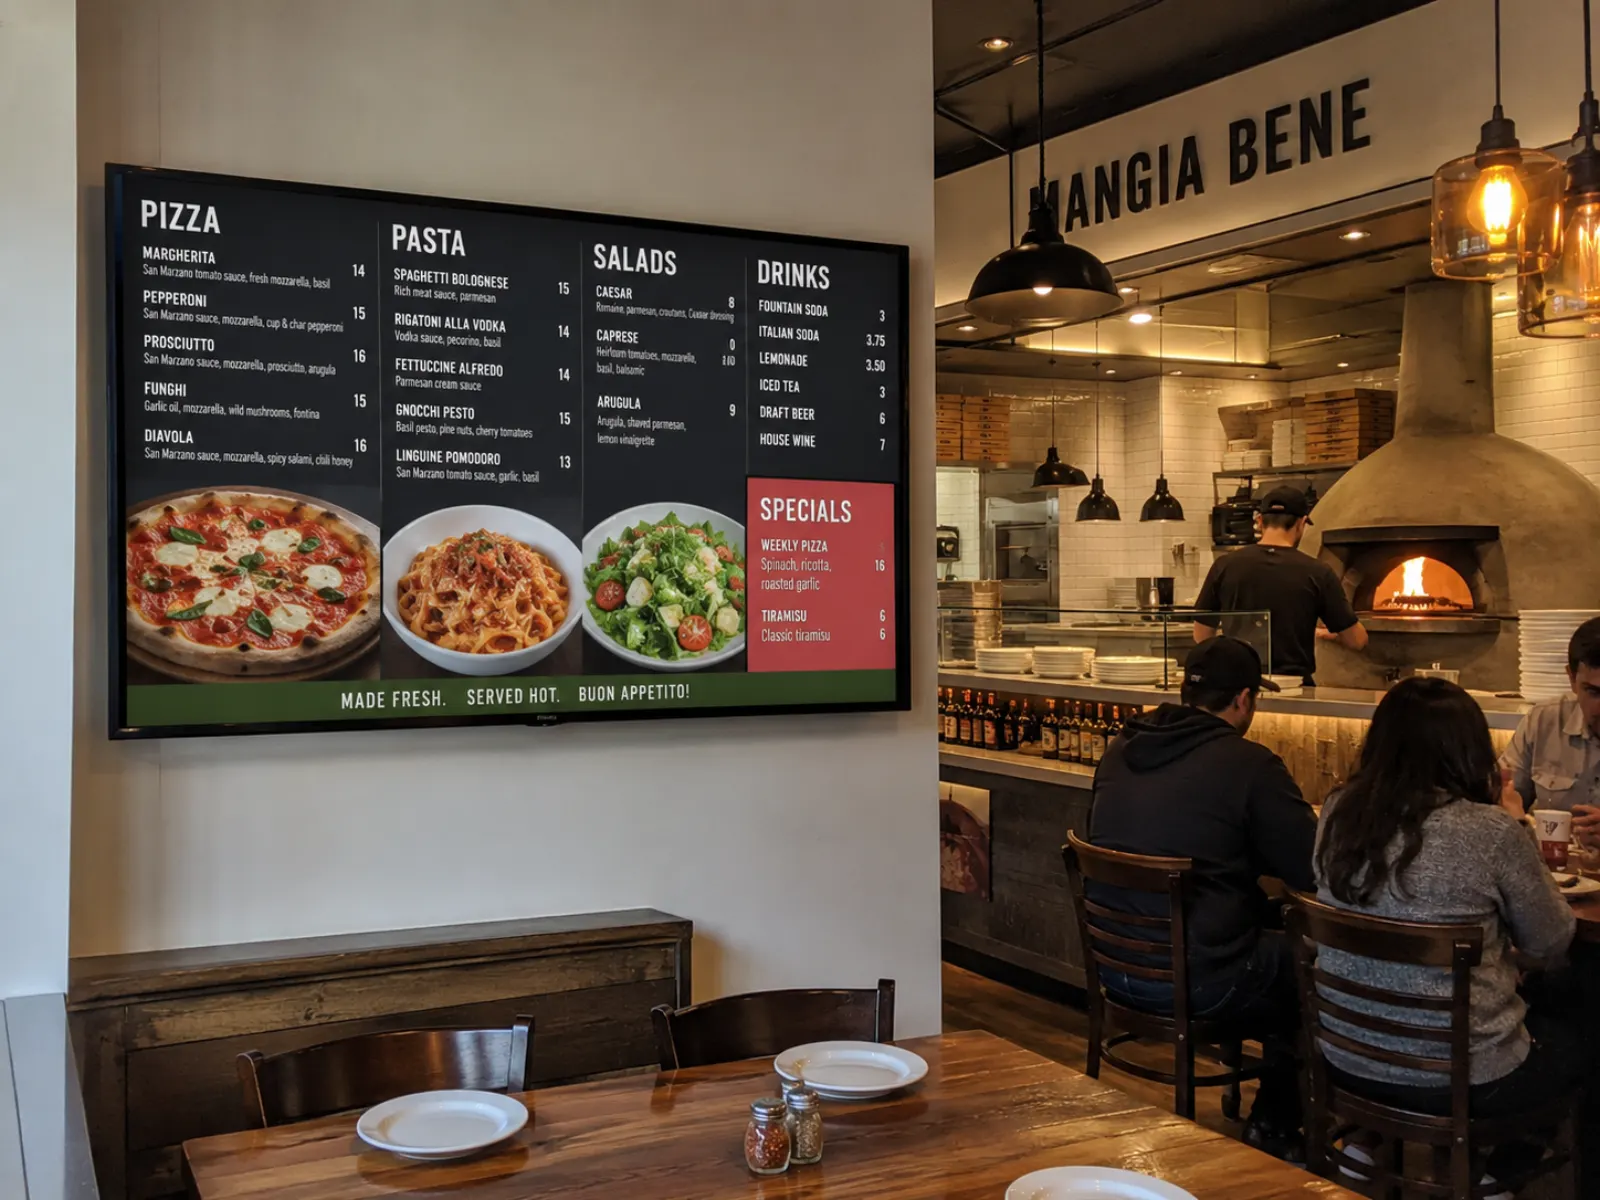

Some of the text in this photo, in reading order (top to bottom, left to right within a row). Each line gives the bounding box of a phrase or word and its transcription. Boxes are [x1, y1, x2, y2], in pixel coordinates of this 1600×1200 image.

[1229, 78, 1371, 185] BENE
[142, 200, 220, 233] PIZZA
[393, 224, 465, 256] PASTA
[143, 246, 215, 264] MARGHERITA
[594, 244, 676, 275] SALADS
[143, 264, 330, 288] San Marzano tomato sauce, fresh mozzarella, basil
[353, 264, 365, 277] 14
[758, 260, 829, 289] DRINKS
[394, 268, 508, 289] SPAGHETTI BOLOGNESE
[394, 285, 411, 296] Rich
[413, 289, 432, 298] meat
[434, 290, 458, 301] sauce,
[559, 282, 569, 295] 15
[596, 285, 632, 299] CAESAR
[144, 290, 206, 307] PEPPERONI
[729, 297, 734, 308] 8
[353, 306, 365, 320] 15
[759, 300, 828, 316] FOUNTAIN SODA
[143, 307, 343, 333] San Marzano sauce, mozzarella, cup & char pepperoni
[395, 313, 506, 332] RIGATONI ALLA VODKA
[880, 310, 885, 322] 3
[395, 330, 418, 342] Vodka
[421, 334, 445, 345] sauce,
[559, 325, 569, 338] 14
[597, 329, 638, 343] CAPRESE
[759, 326, 819, 341] ITALIAN SODA
[144, 335, 214, 351] PROSCIUTTO
[867, 334, 885, 347] 3.75
[354, 349, 366, 363] 16
[760, 352, 807, 367] LEMONADE
[144, 352, 159, 364] San
[161, 354, 194, 366] Marzano
[196, 359, 221, 369] sauce,
[223, 359, 266, 371] mozzarella,
[308, 364, 336, 377] arugula
[396, 358, 503, 377] FETTUCCINE ALFREDO
[866, 359, 885, 372] 3.50
[559, 368, 570, 381] 14
[145, 382, 186, 397] FUNGHI
[395, 375, 481, 391] Parmesan cream sauce
[760, 379, 800, 392] ICED TEA
[880, 386, 885, 398] 3
[354, 394, 366, 407] 15
[598, 396, 641, 409] ARUGULA
[144, 400, 320, 419] Garlic oil, mozzarella, wild mushrooms, fontina
[396, 403, 474, 419] GNOCCHI PESTO
[730, 404, 735, 416] 9
[760, 406, 814, 420] DRAFT BEER
[560, 412, 570, 425] 15
[880, 412, 885, 424] 6
[145, 429, 193, 443] DIAVOLA
[396, 421, 414, 432] Basil
[416, 424, 438, 435] pesto,
[440, 423, 455, 436] pine
[456, 426, 474, 436] nuts,
[476, 425, 499, 439] cherry
[355, 439, 367, 452] 16
[760, 433, 815, 447] HOUSE WINE
[880, 439, 885, 450] 7
[145, 447, 160, 459] San
[162, 448, 195, 460] Marzano
[197, 452, 221, 462] sauce,
[223, 452, 266, 464] mozzarella,
[267, 455, 287, 466] spicy
[396, 449, 500, 465] LINGUINE POMODORO
[560, 456, 570, 468] 13
[396, 466, 411, 477] San
[413, 467, 445, 479] Marzano
[446, 469, 472, 480] tomato
[761, 497, 851, 522] SPECIALS
[761, 539, 828, 552] WEEKLY PIZZA
[761, 557, 831, 573] Spinach, ricotta,
[875, 560, 885, 571] 16
[761, 577, 820, 593] roasted garlic
[762, 610, 806, 622] TIRAMISU
[880, 609, 885, 621] 6
[762, 628, 830, 642] Classic tiramisu
[880, 628, 885, 640] 6
[342, 684, 689, 709] MADE FRESH. SERVED HOT. BUON APPETITO!
